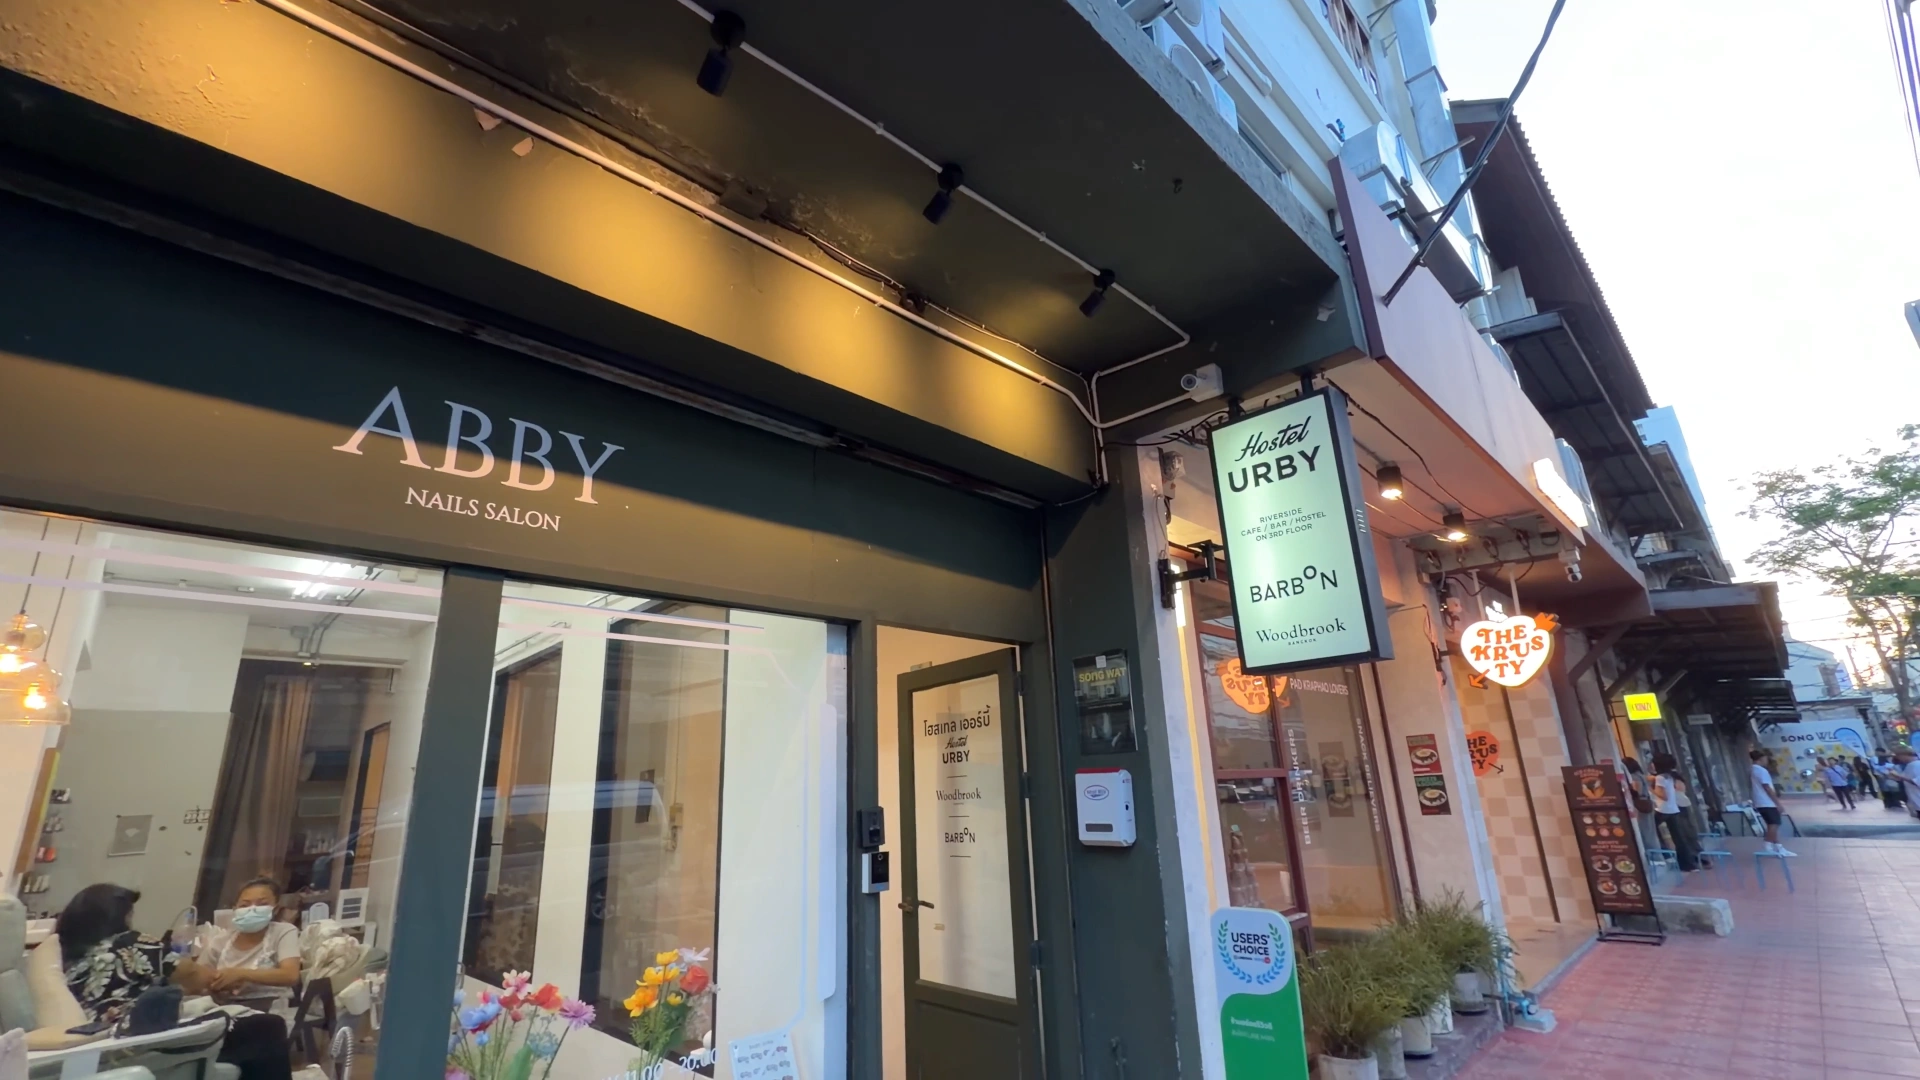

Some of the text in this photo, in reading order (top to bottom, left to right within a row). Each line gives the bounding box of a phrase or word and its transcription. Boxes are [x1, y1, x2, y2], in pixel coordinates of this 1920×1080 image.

[332, 385, 625, 506] ABBY
[1234, 415, 1312, 462] Hostel
[1228, 445, 1321, 493] URBY
[405, 487, 561, 532] NAILS SALON
[1259, 507, 1303, 523] RIVERSIDE
[1240, 526, 1262, 537] CAFE
[1270, 520, 1287, 530] BAR
[1295, 511, 1327, 524] HOSTEL
[1255, 523, 1313, 542] ON 3RD FLOOR
[1249, 565, 1339, 603] BARBON
[1256, 617, 1347, 644] Woodbrook
[1476, 624, 1527, 645] THE
[1470, 635, 1545, 661] KRUS
[1105, 667, 1127, 679] WAT
[1494, 659, 1526, 678] TY
[1289, 677, 1349, 696] PAD KRAPHAO LOVERS
[923, 719, 957, 737] โฮสเทล
[944, 735, 969, 750] Hostel
[1467, 736, 1487, 749] HE
[1781, 734, 1815, 743] SONG
[942, 749, 970, 764] URBY
[1468, 744, 1498, 759] RUS
[1288, 729, 1305, 803] DRINKERS
[936, 787, 982, 801] Woodbrook
[944, 827, 976, 843] BARBON
[1232, 944, 1270, 956] CHOICE
